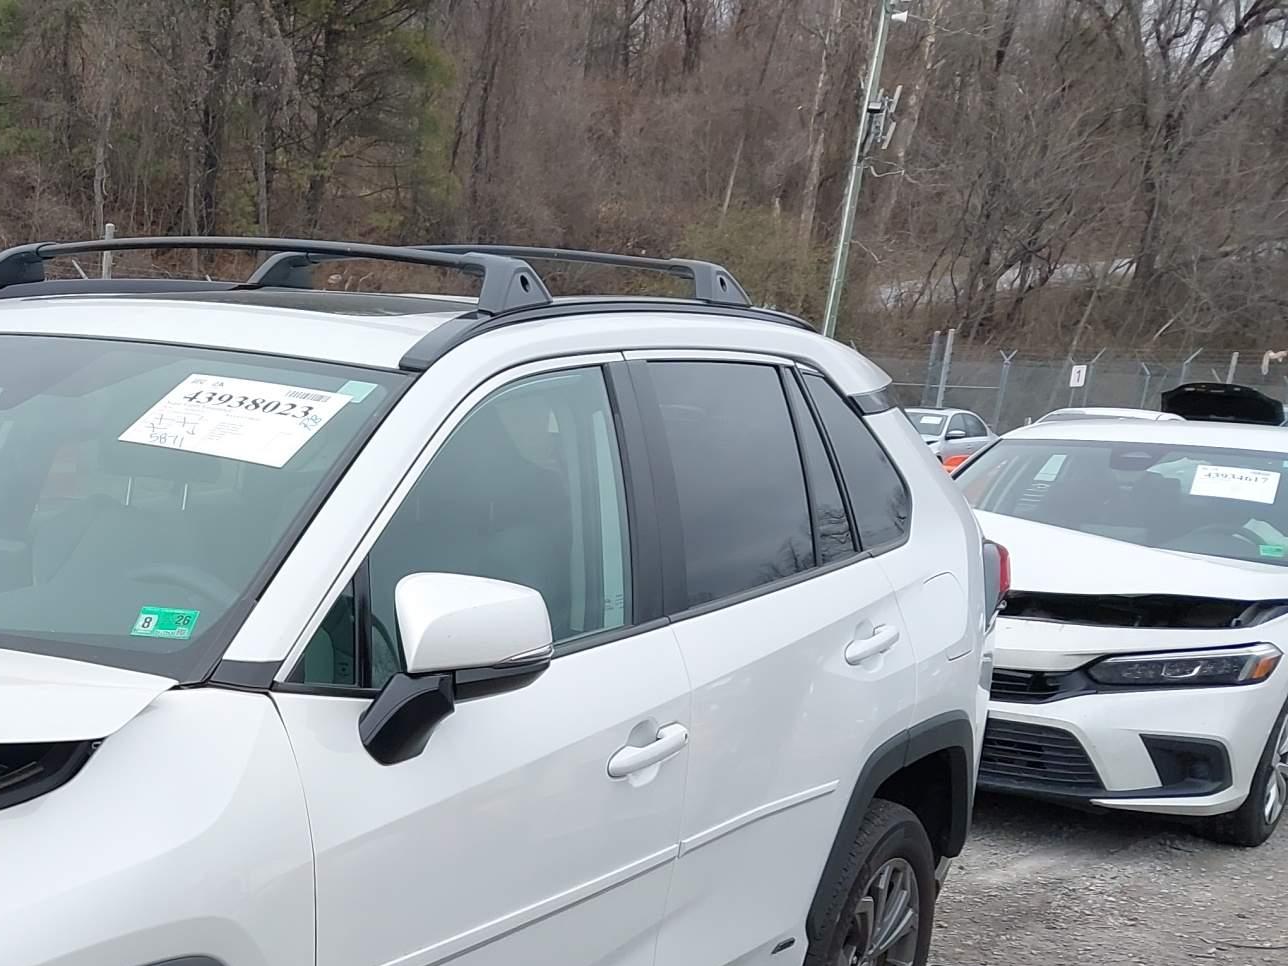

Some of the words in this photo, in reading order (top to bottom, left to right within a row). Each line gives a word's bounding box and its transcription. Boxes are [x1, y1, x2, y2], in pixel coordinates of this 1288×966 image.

[183, 389, 314, 418] 43938023
[141, 616, 153, 629] 8
[175, 614, 192, 626] 26
